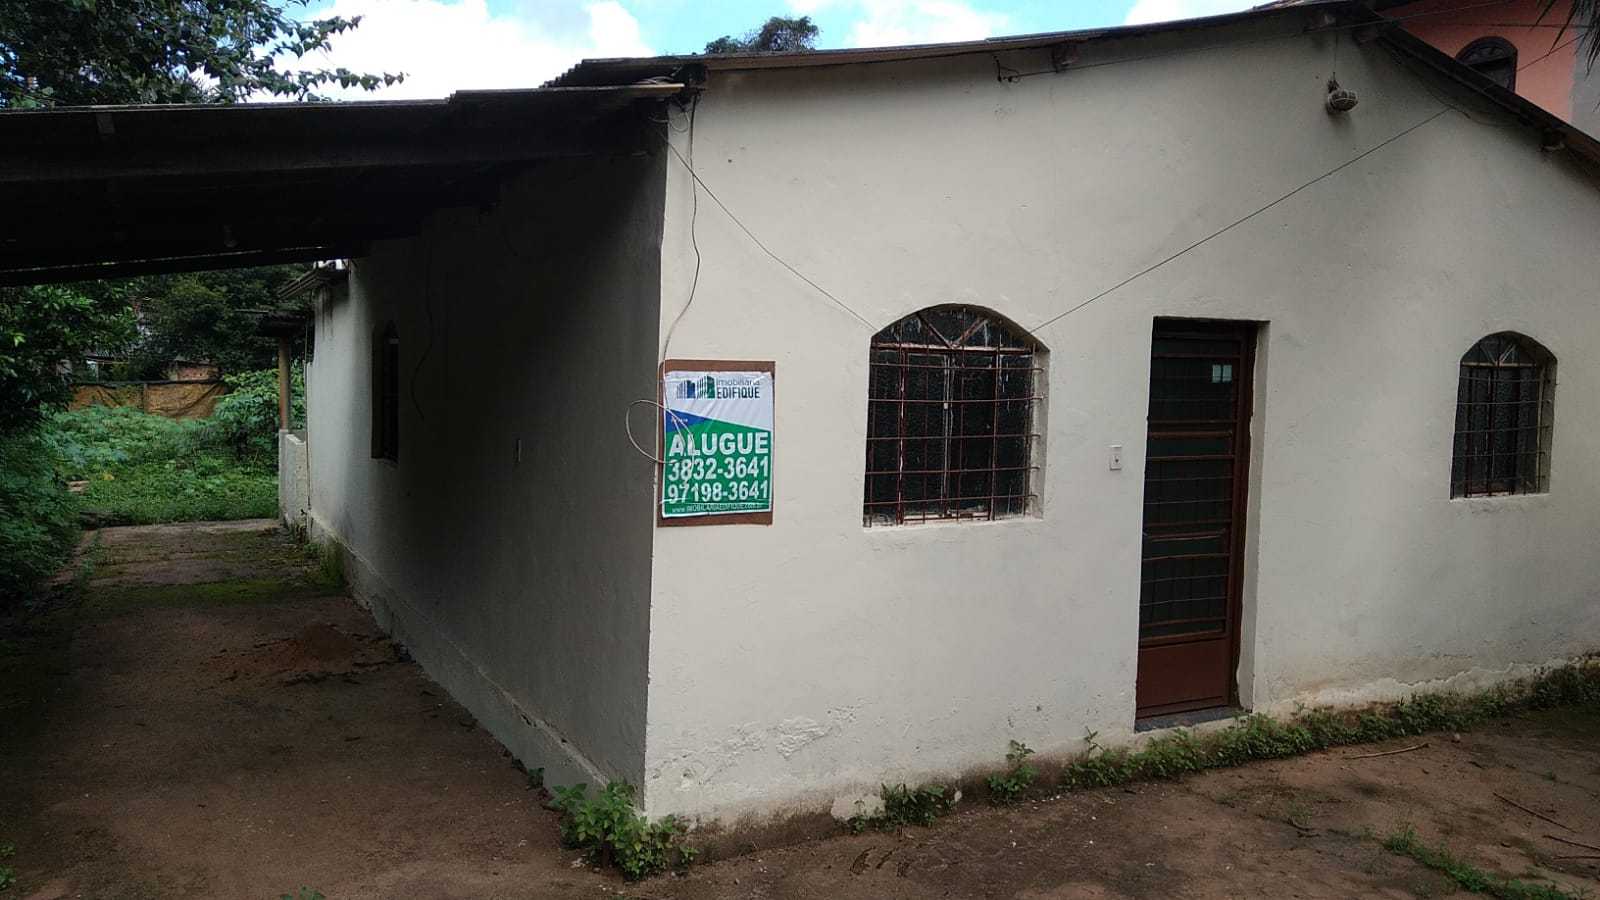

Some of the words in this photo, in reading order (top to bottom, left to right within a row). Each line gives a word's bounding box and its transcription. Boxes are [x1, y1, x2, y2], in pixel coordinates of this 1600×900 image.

[716, 387, 760, 399] EDIFIQUE
[668, 433, 769, 457] ALUGUE
[668, 455, 769, 481] 3832-3641
[667, 479, 768, 504] 97198-3641
